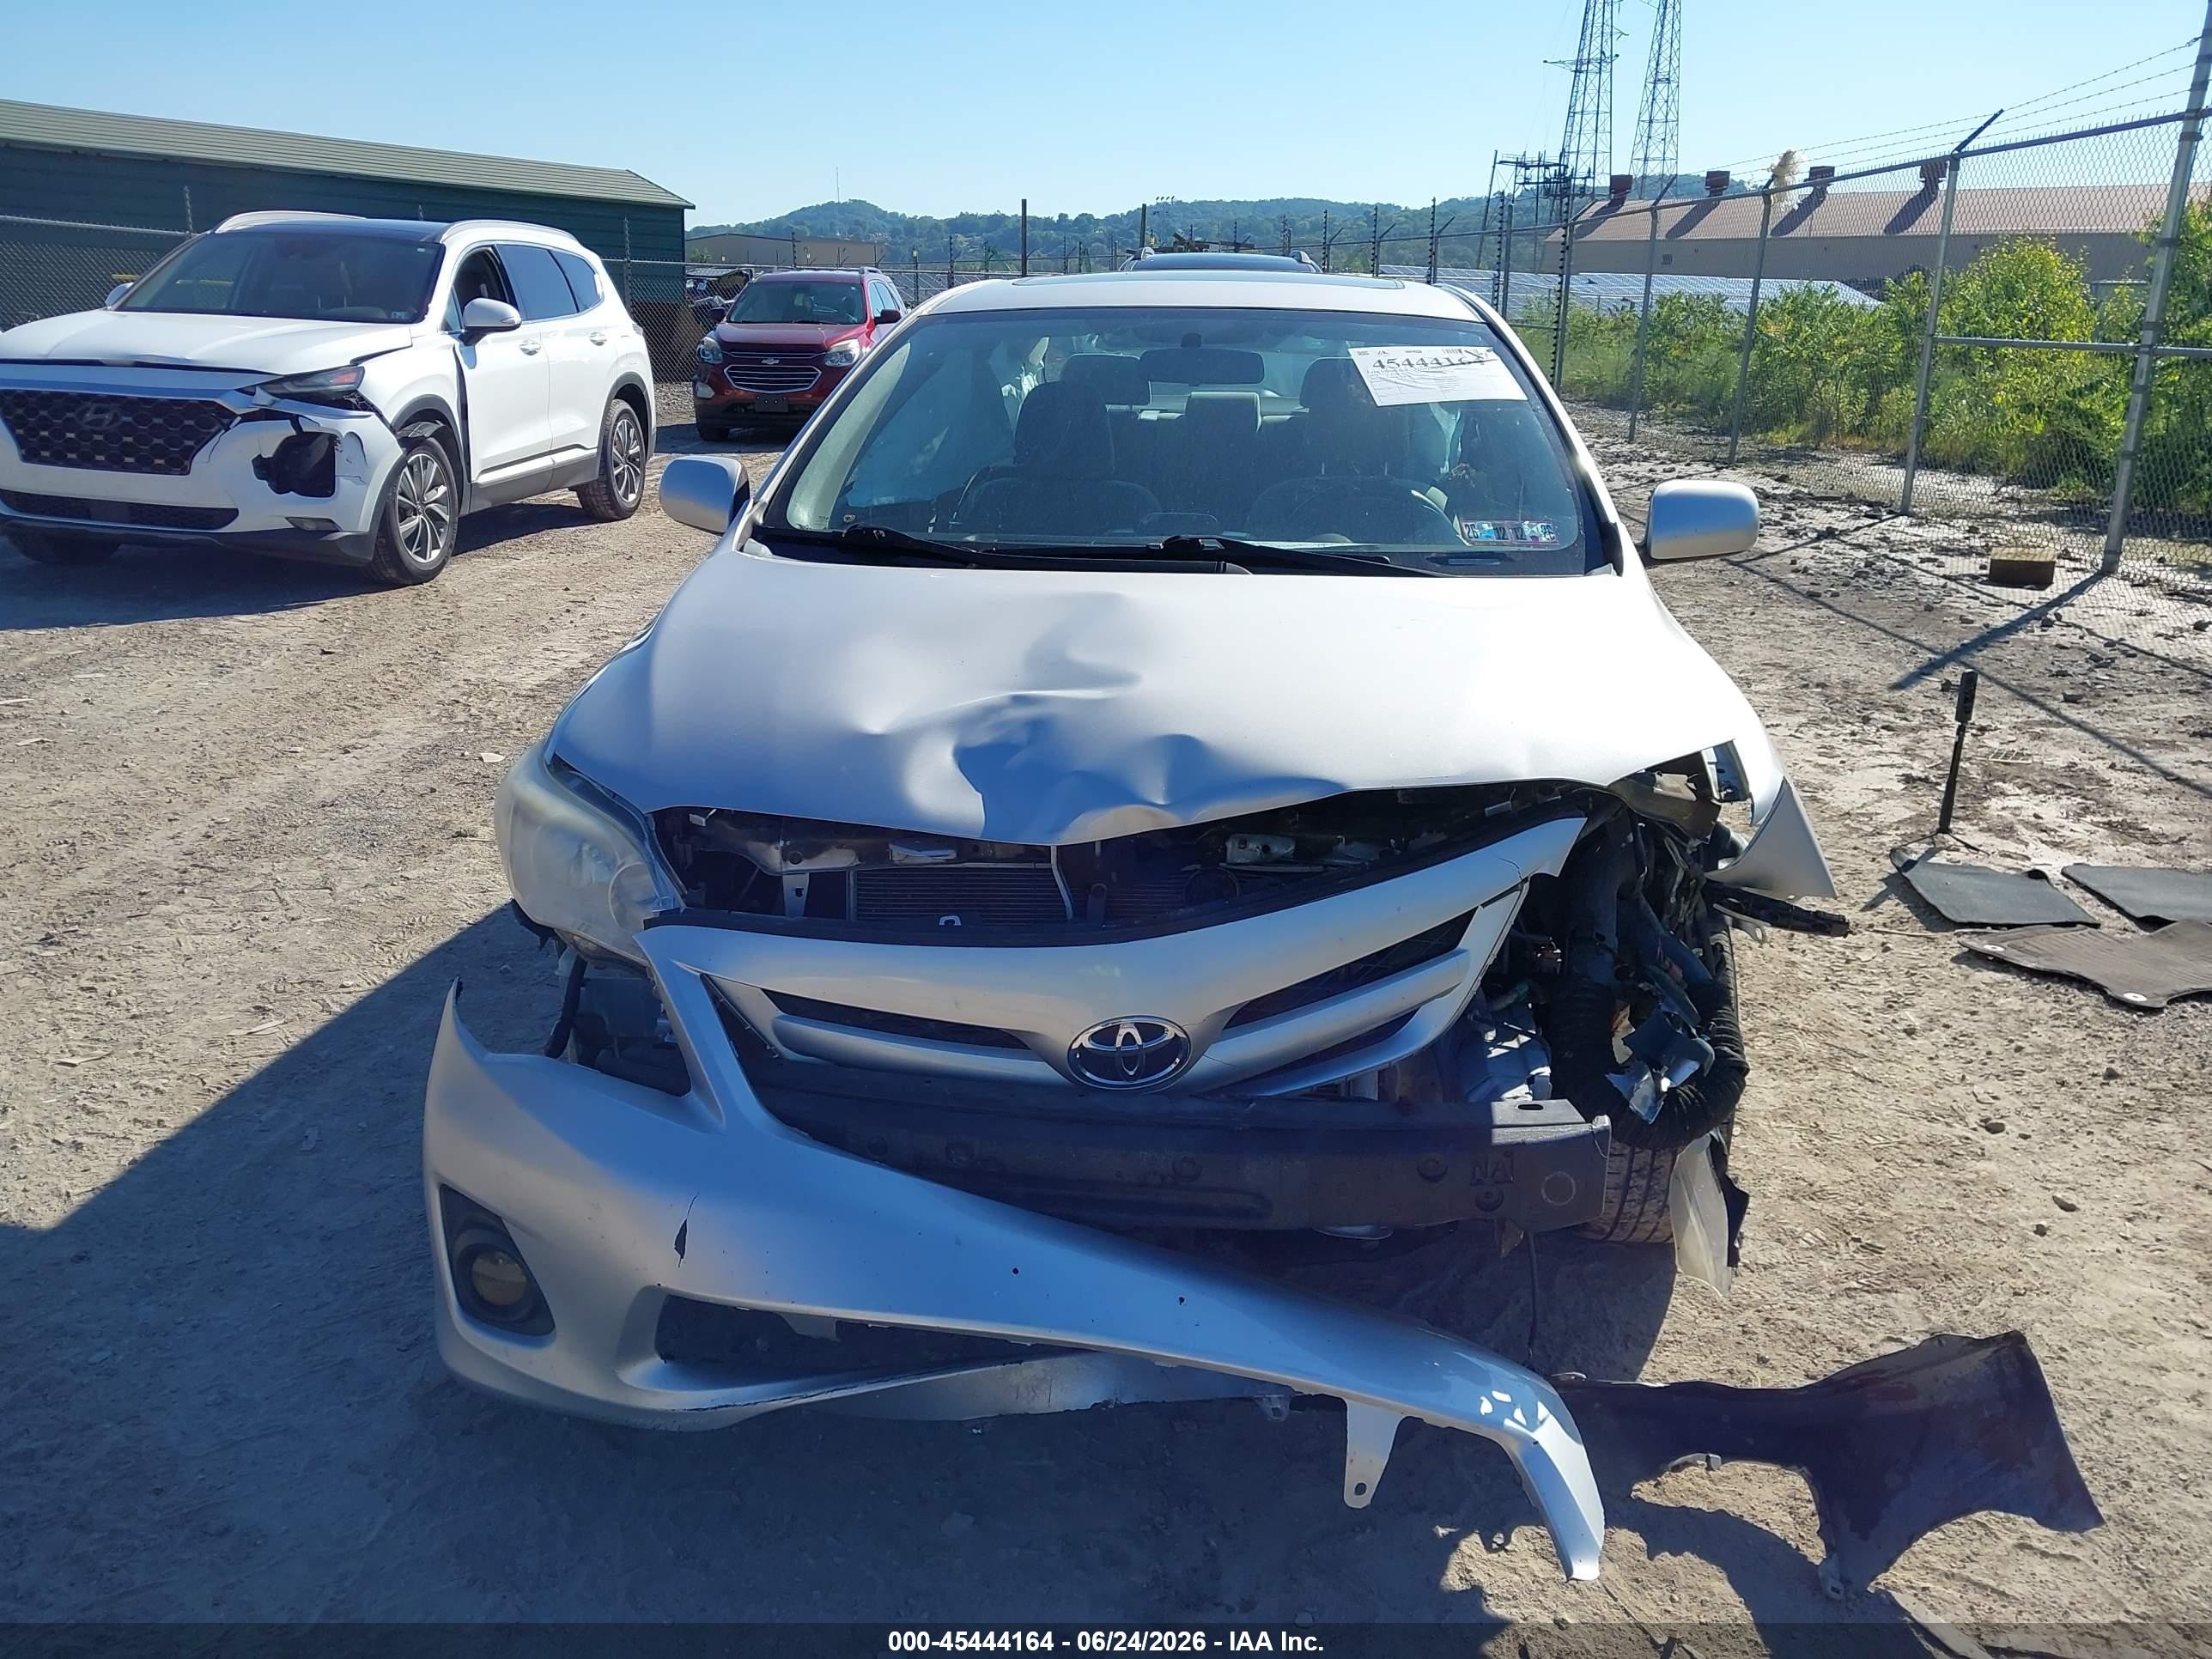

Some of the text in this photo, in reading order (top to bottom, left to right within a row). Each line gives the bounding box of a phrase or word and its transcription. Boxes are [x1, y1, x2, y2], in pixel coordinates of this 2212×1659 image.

[1464, 524, 1479, 539] 26
[1493, 526, 1509, 540] 12
[1511, 526, 1527, 541] 12
